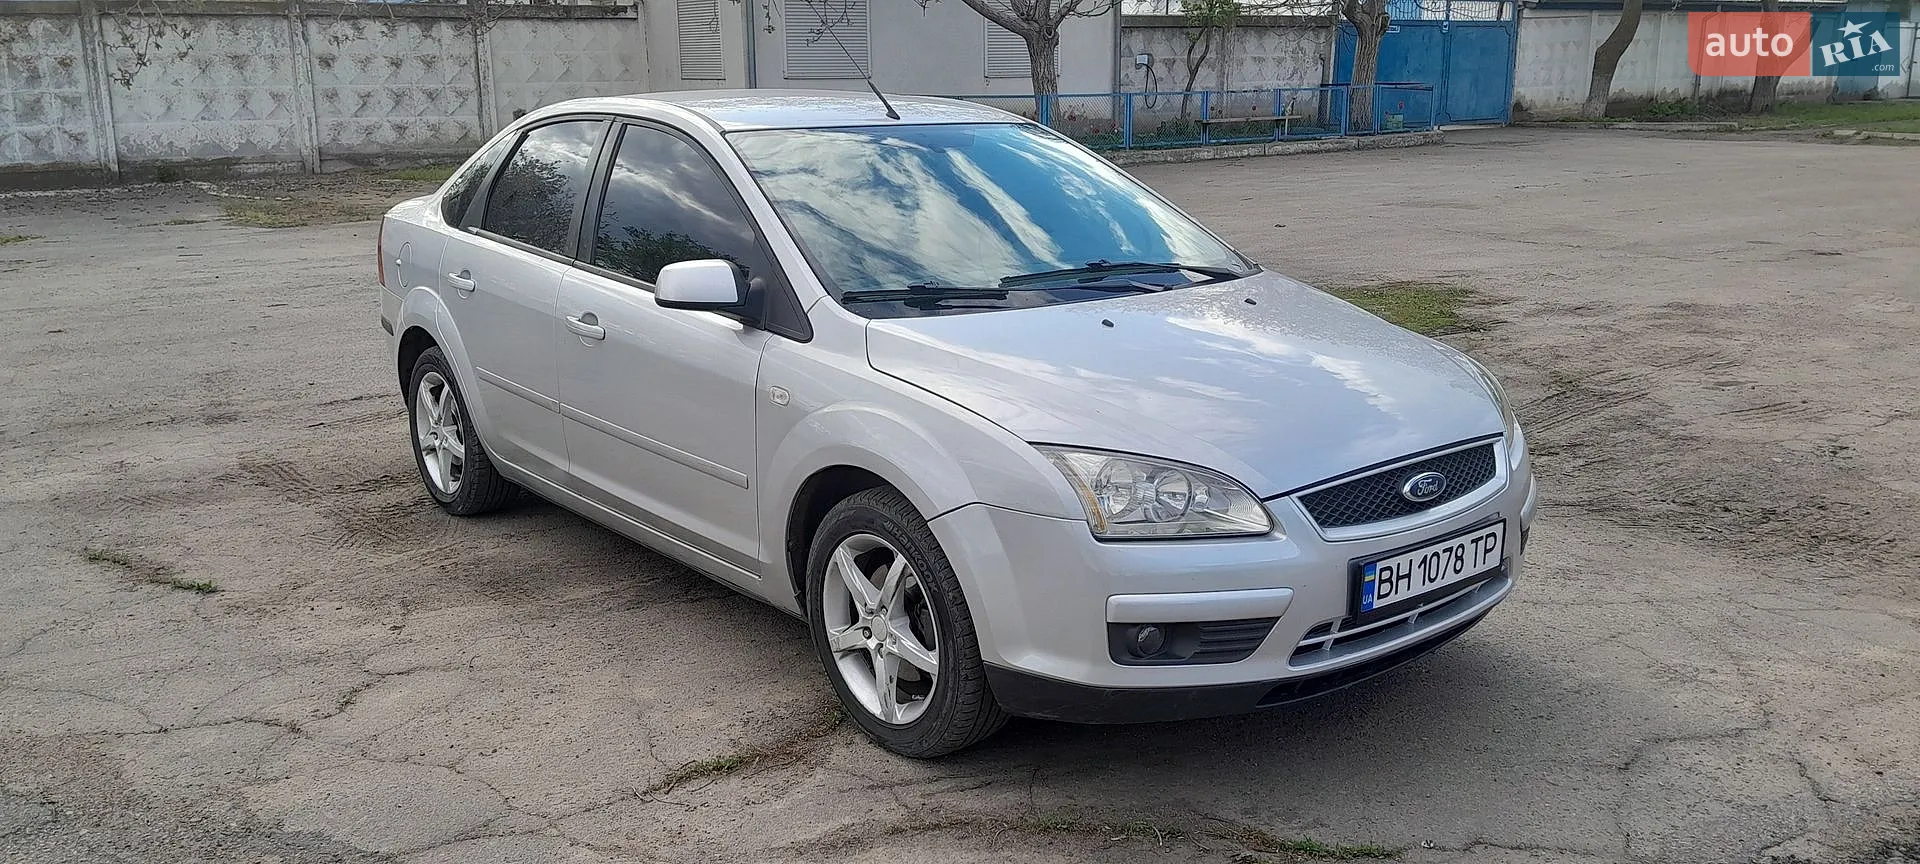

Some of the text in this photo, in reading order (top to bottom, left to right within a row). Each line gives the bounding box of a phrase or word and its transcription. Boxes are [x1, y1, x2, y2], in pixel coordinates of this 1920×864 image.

[1417, 478, 1439, 496] Ford
[1377, 531, 1498, 600] BH 1078 TP
[1362, 593, 1373, 605] UA
